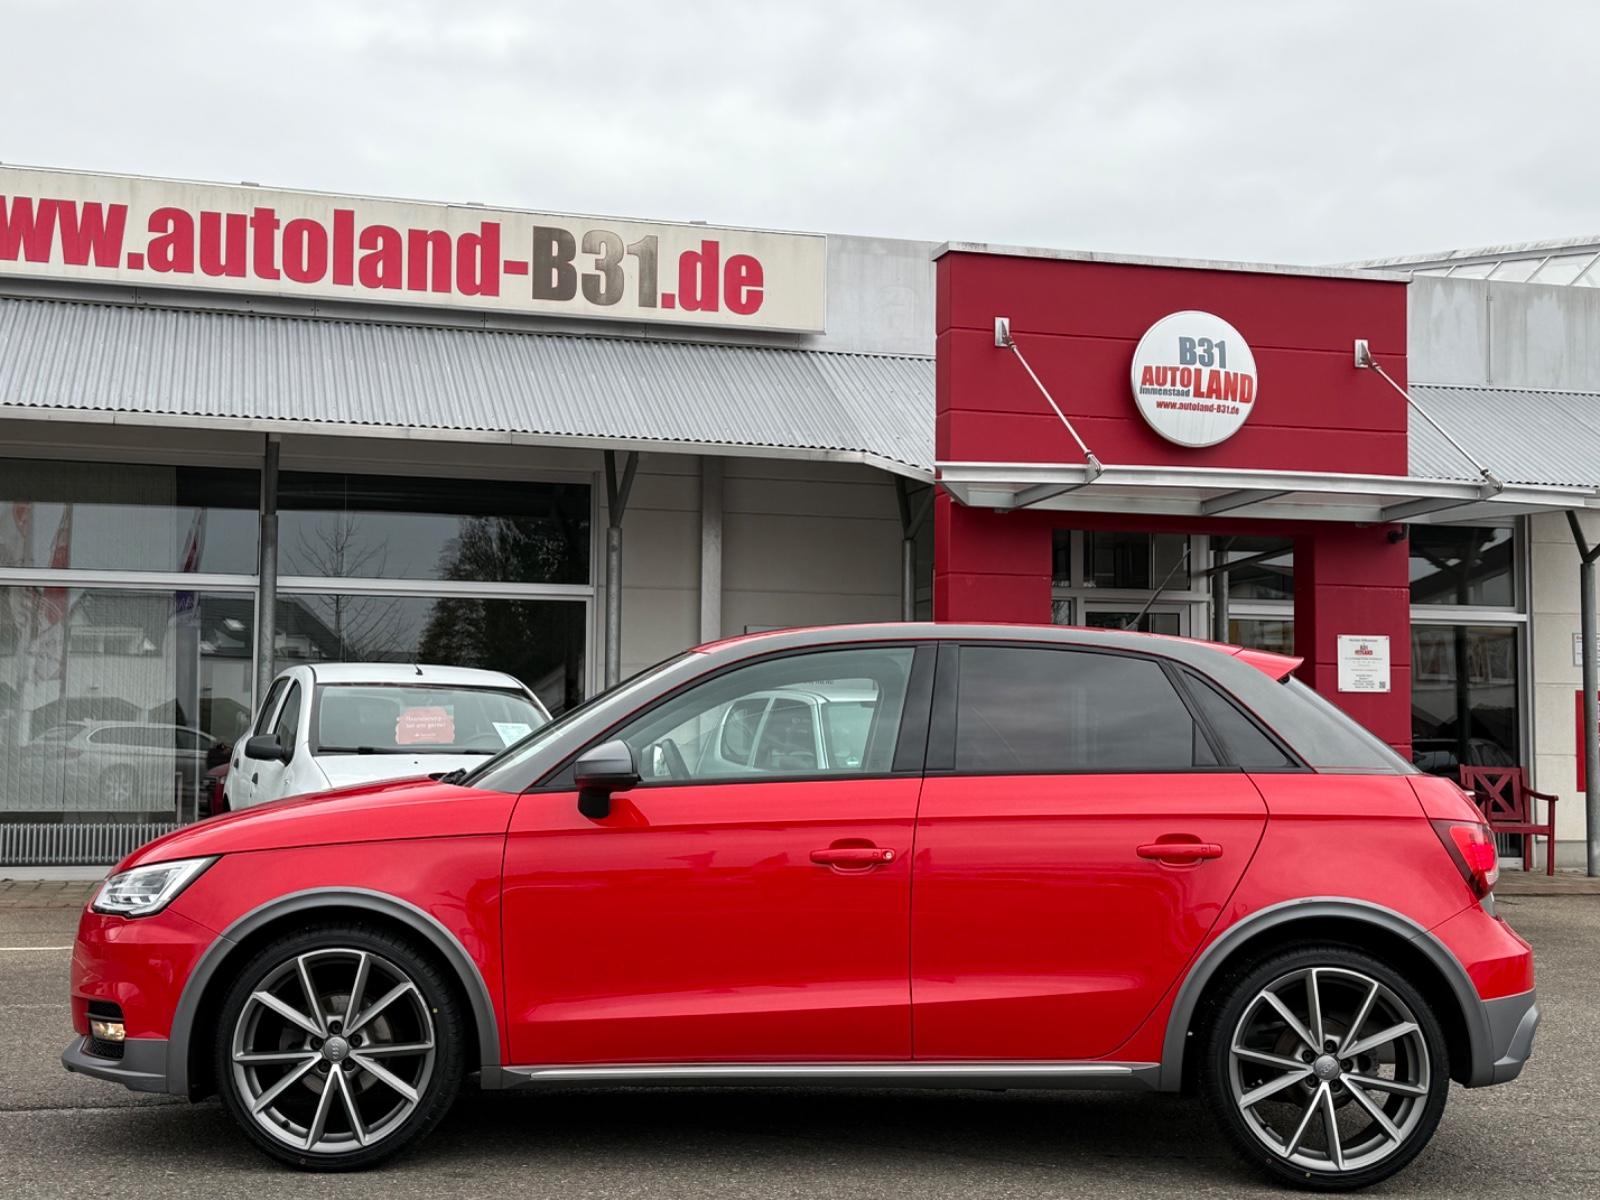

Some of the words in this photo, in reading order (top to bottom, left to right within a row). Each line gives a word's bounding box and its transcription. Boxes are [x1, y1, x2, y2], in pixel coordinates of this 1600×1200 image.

[1178, 336, 1227, 369] B31
[1141, 365, 1254, 404] AUTOLAND
[1156, 401, 1240, 415] www.autoland-B31.de
